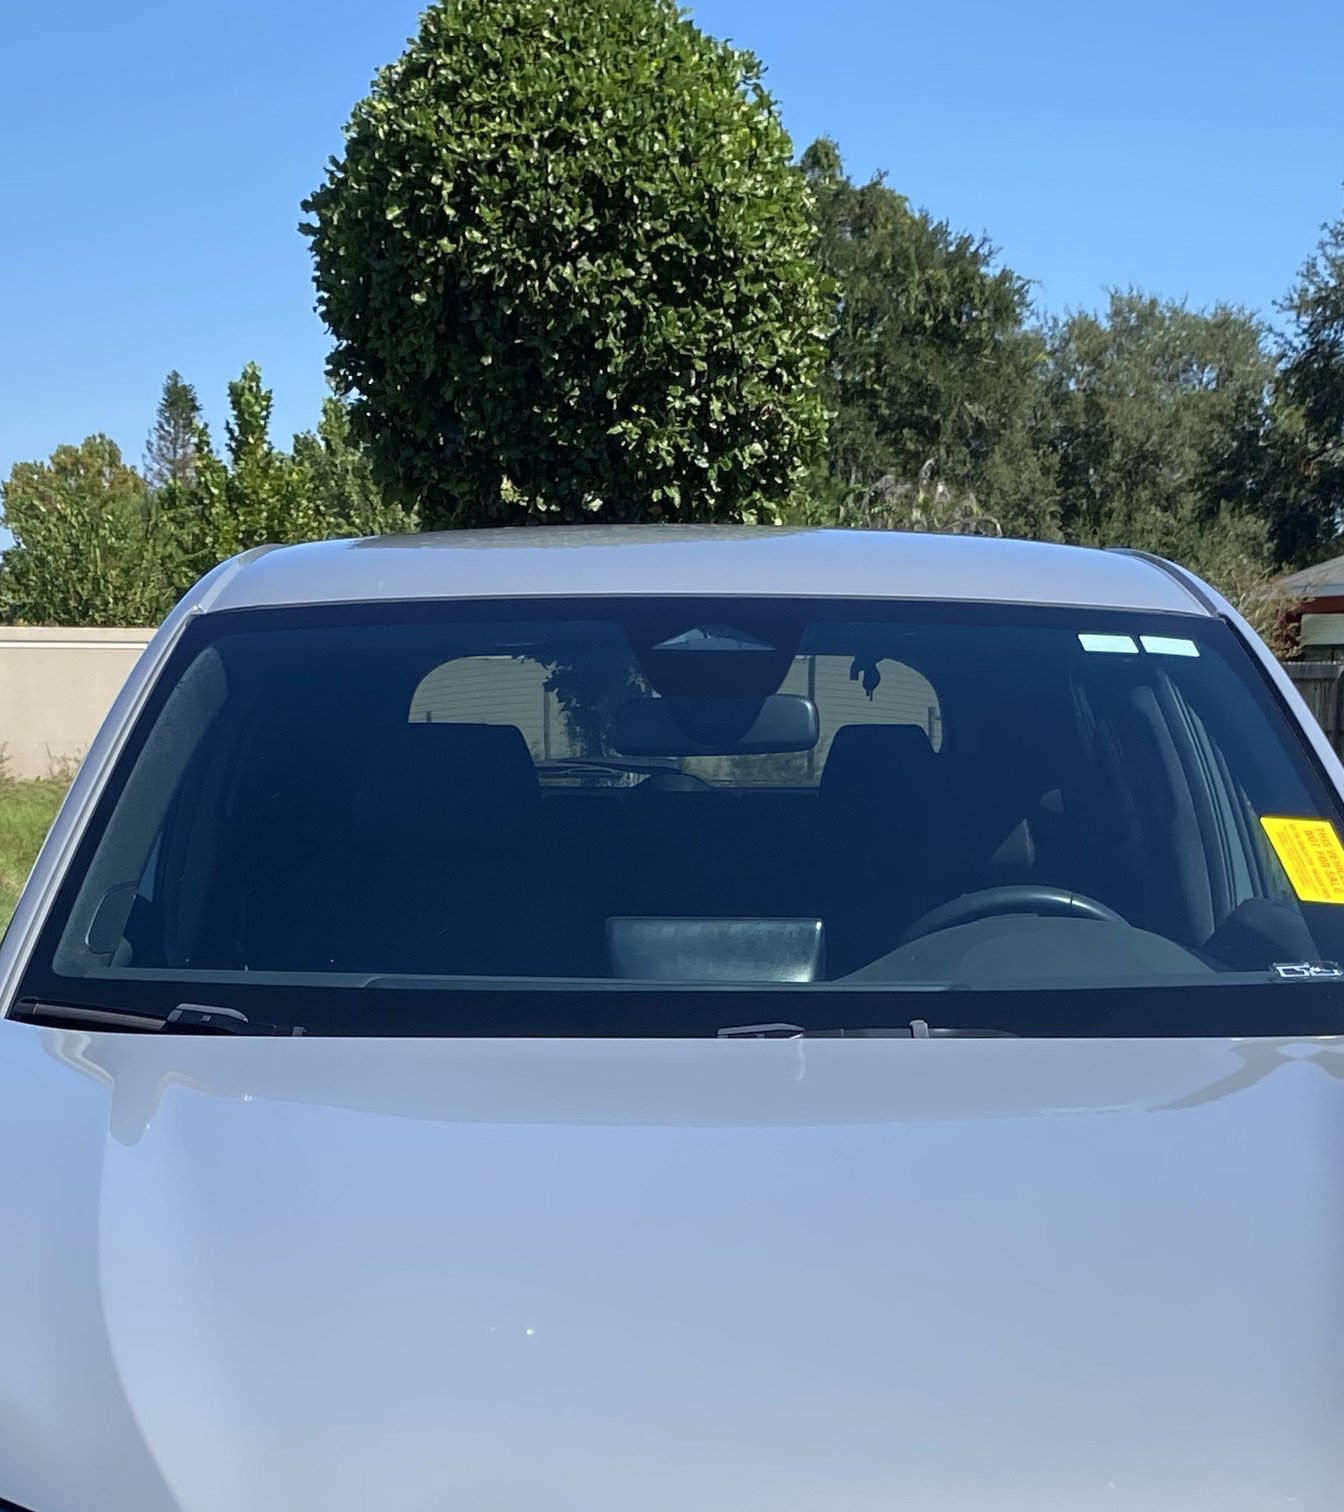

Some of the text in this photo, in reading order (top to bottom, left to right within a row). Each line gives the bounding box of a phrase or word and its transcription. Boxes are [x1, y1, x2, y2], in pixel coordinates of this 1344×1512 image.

[1315, 827, 1332, 848] THIS
[1304, 830, 1321, 848] NOT
[1315, 850, 1330, 868] FOR
[1325, 870, 1344, 893] SALE
